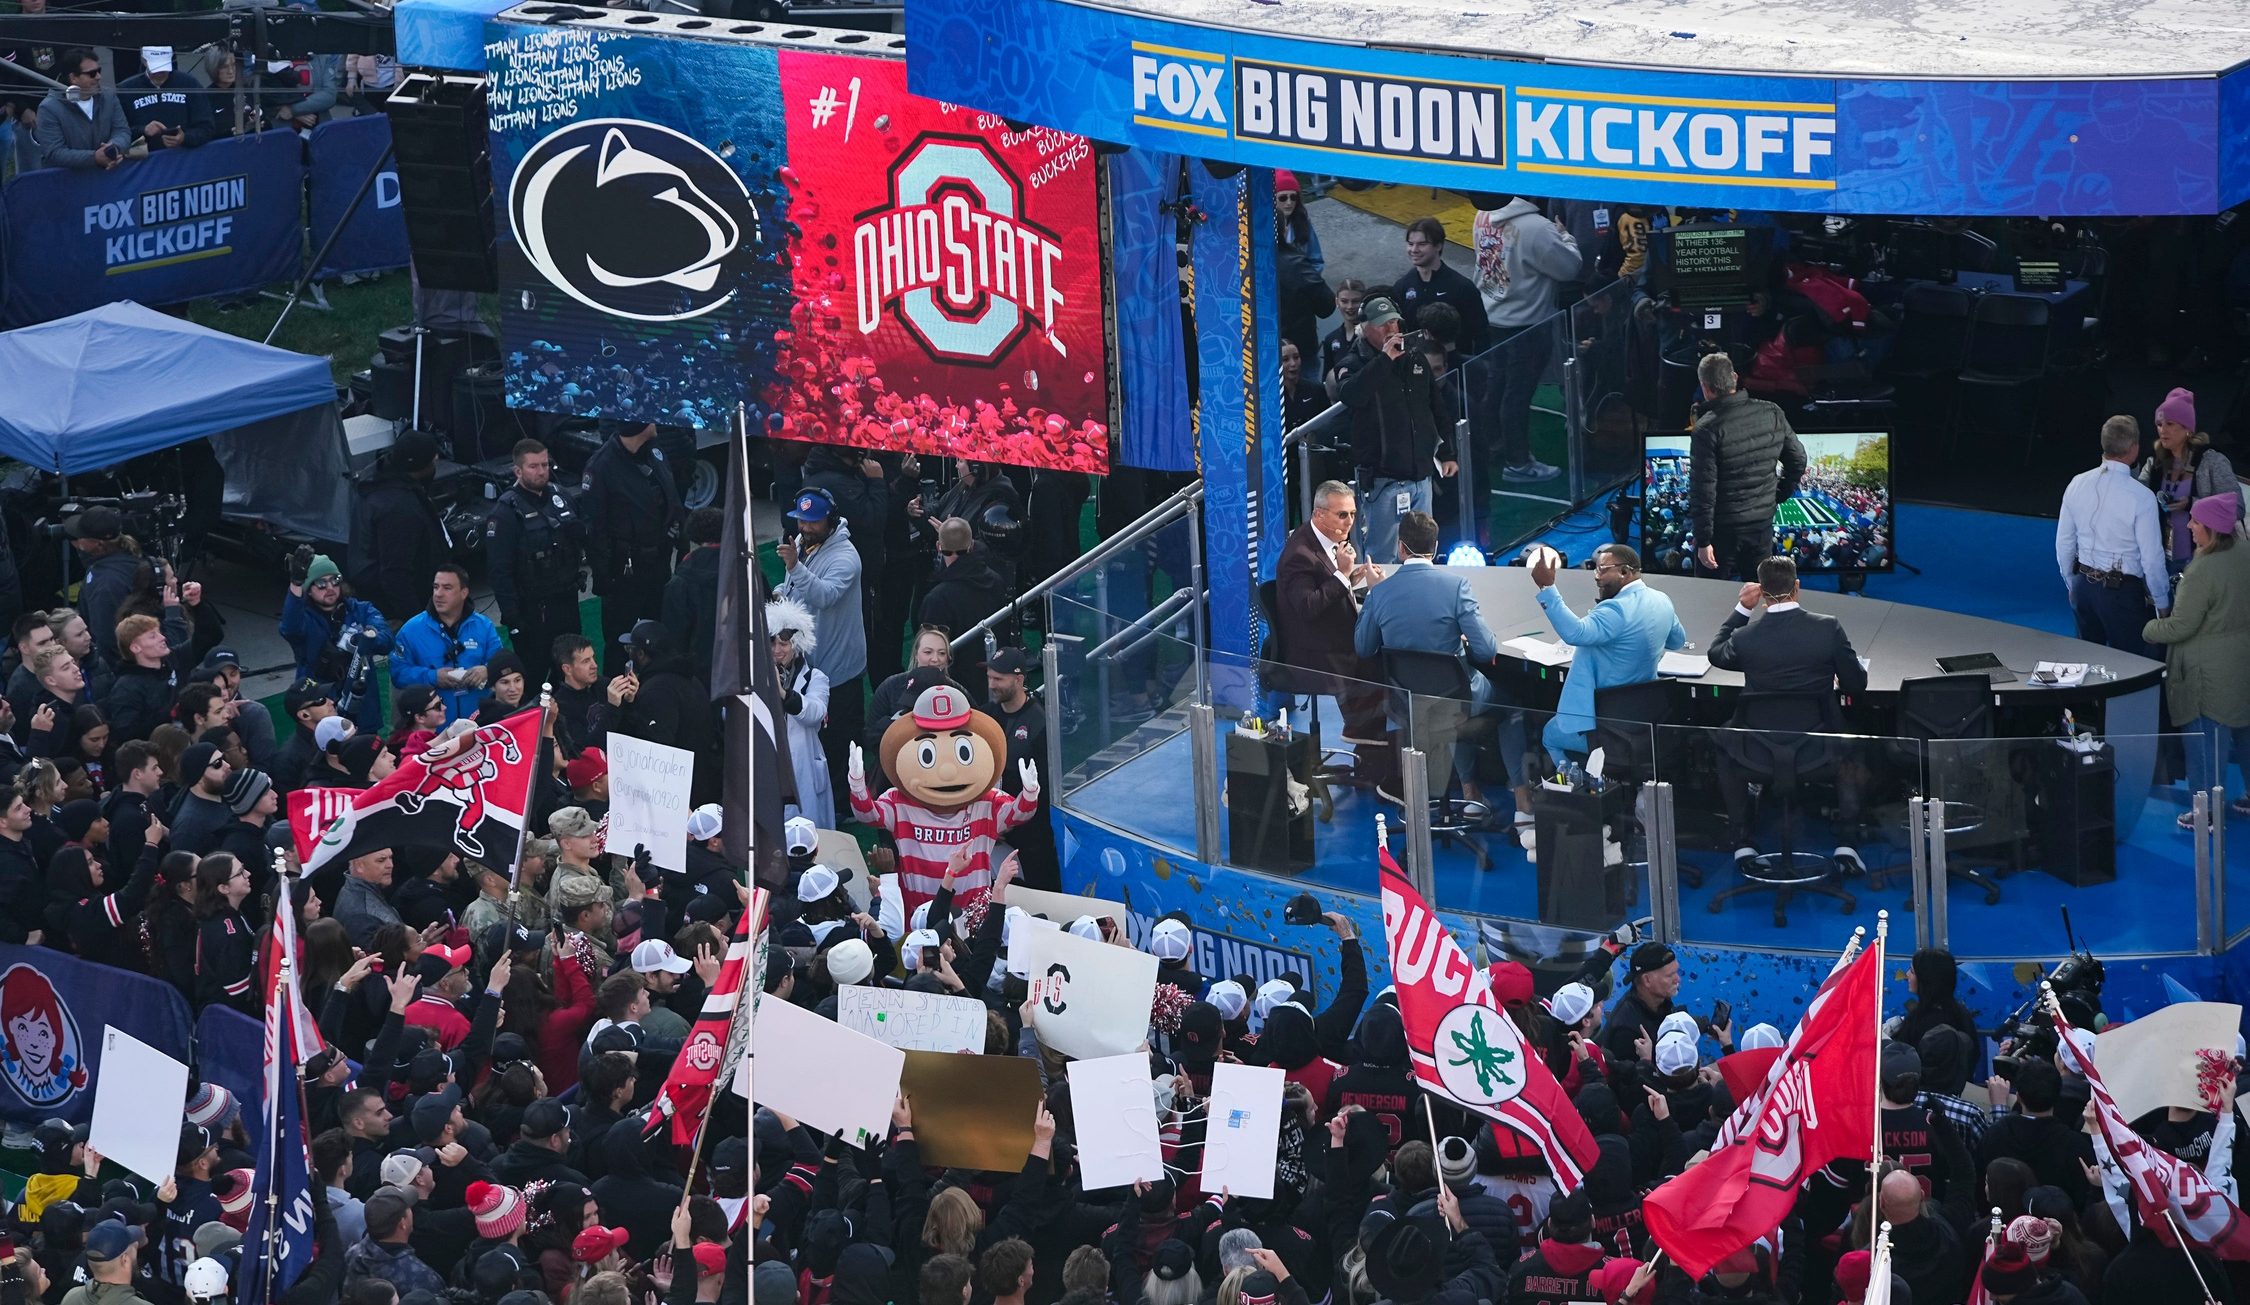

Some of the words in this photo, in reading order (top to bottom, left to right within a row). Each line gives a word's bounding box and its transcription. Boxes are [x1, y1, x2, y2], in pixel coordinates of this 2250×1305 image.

[509, 48, 557, 69] NITTANY
[563, 43, 600, 64] LIONS
[504, 65, 540, 87] LIONS
[589, 55, 626, 78] LIONS
[517, 86, 554, 105] LIONS
[605, 67, 642, 91] LIONS
[133, 94, 158, 110] PENN
[161, 92, 188, 104] STATE
[809, 76, 861, 143] #1
[489, 107, 537, 132] NITTANY
[542, 98, 579, 123] LIONS
[1132, 55, 1227, 123] FOX
[1241, 66, 1328, 143] BIG
[1340, 78, 1495, 160] NOON
[1516, 101, 1836, 174] KICKOFF
[1029, 135, 1089, 189] BUCKEYES
[84, 198, 136, 235] FOX
[142, 189, 180, 225] BIG
[184, 177, 245, 218] NOON
[106, 216, 233, 265] KICKOFF
[1675, 240, 1684, 248] IN
[1685, 239, 1709, 247] THIER
[1675, 248, 1698, 257] YEAR
[1698, 246, 1740, 256] FOOTBALL
[1675, 257, 1712, 266] HISTORY,
[1713, 256, 1732, 264] THIS
[1706, 315, 1714, 325] 3
[913, 826, 971, 843] BRUTUS
[841, 986, 905, 1011] PENN
[916, 992, 984, 1013] STATE
[951, 1015, 979, 1041] IN
[1341, 1091, 1407, 1112] HENDERSON
[1595, 1207, 1643, 1233] MILLER
[1524, 1275, 1579, 1295] BARRETT
